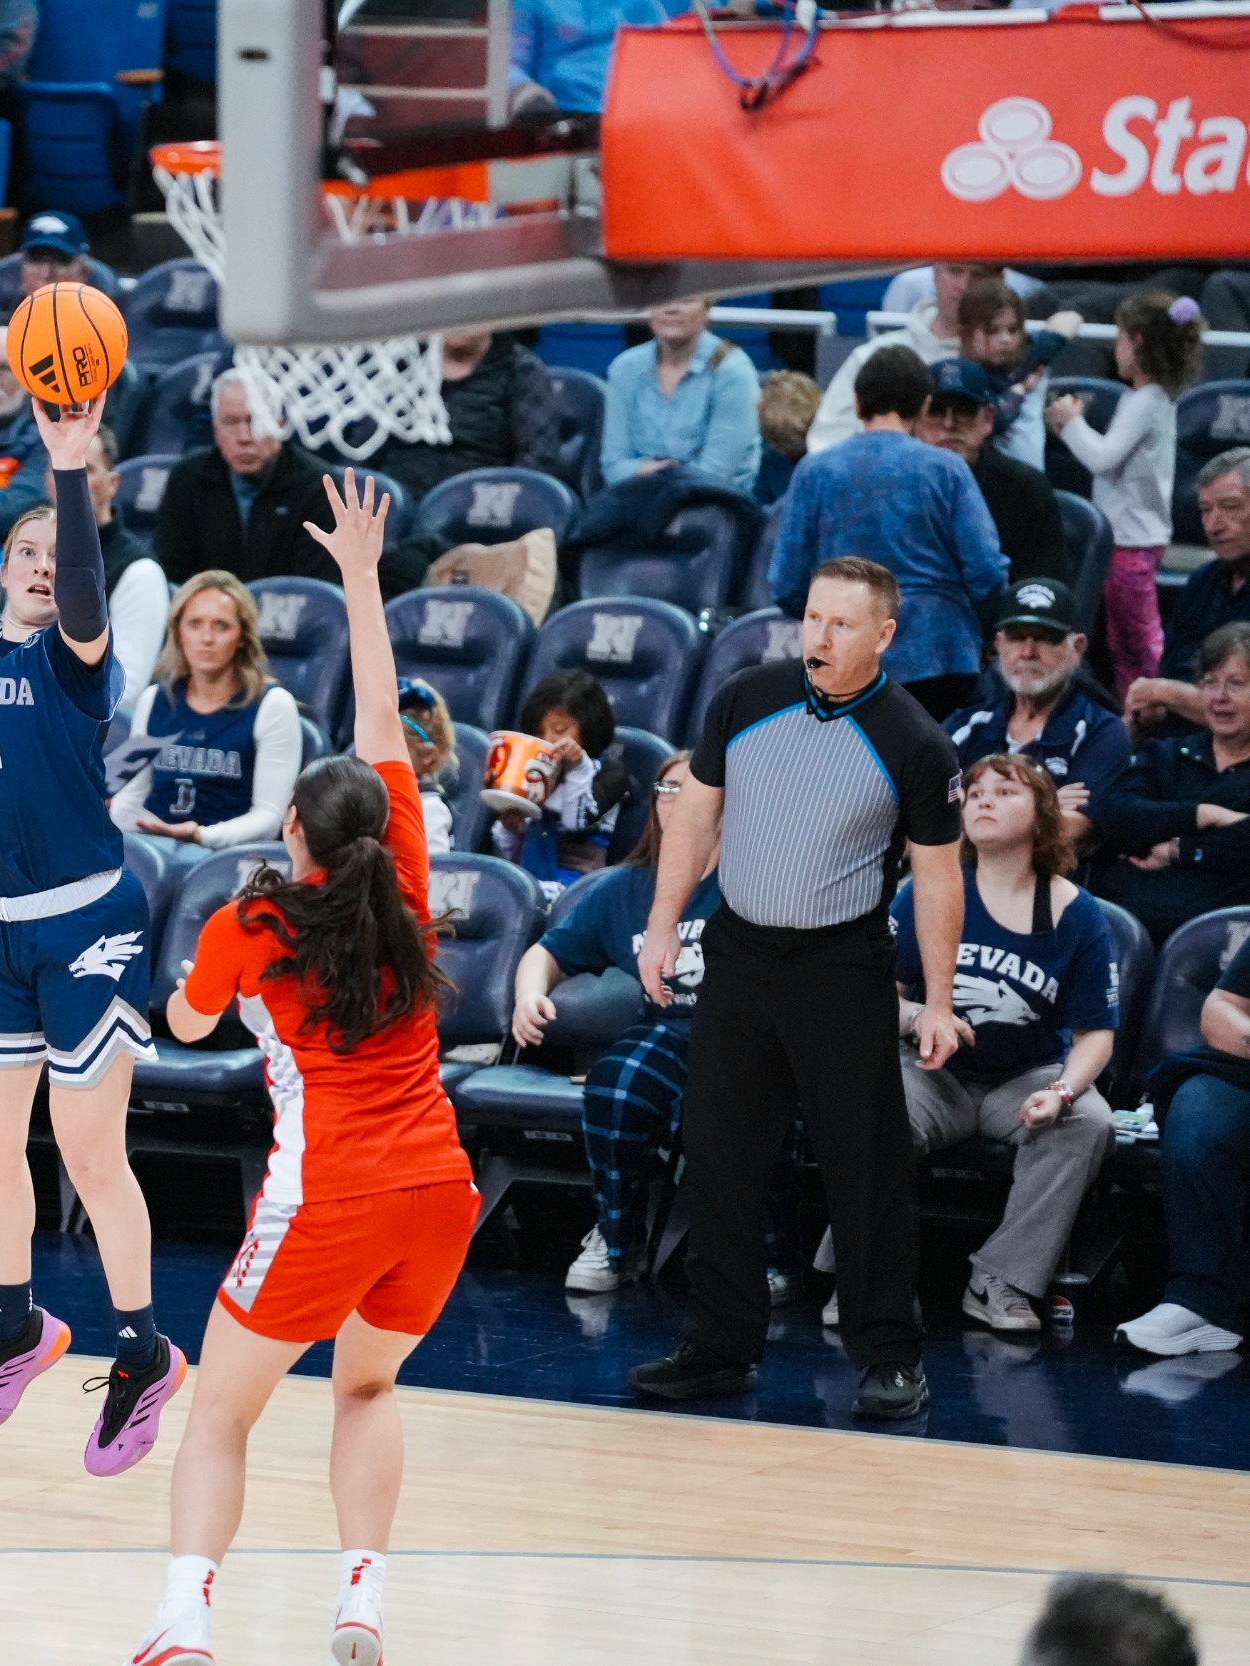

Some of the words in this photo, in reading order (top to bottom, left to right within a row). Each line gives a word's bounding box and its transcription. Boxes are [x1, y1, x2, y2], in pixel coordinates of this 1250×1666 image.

[1090, 95, 1250, 197] Sta
[72, 346, 91, 387] PRO
[154, 745, 242, 779] EVADA
[956, 942, 1060, 1004] EVADA
